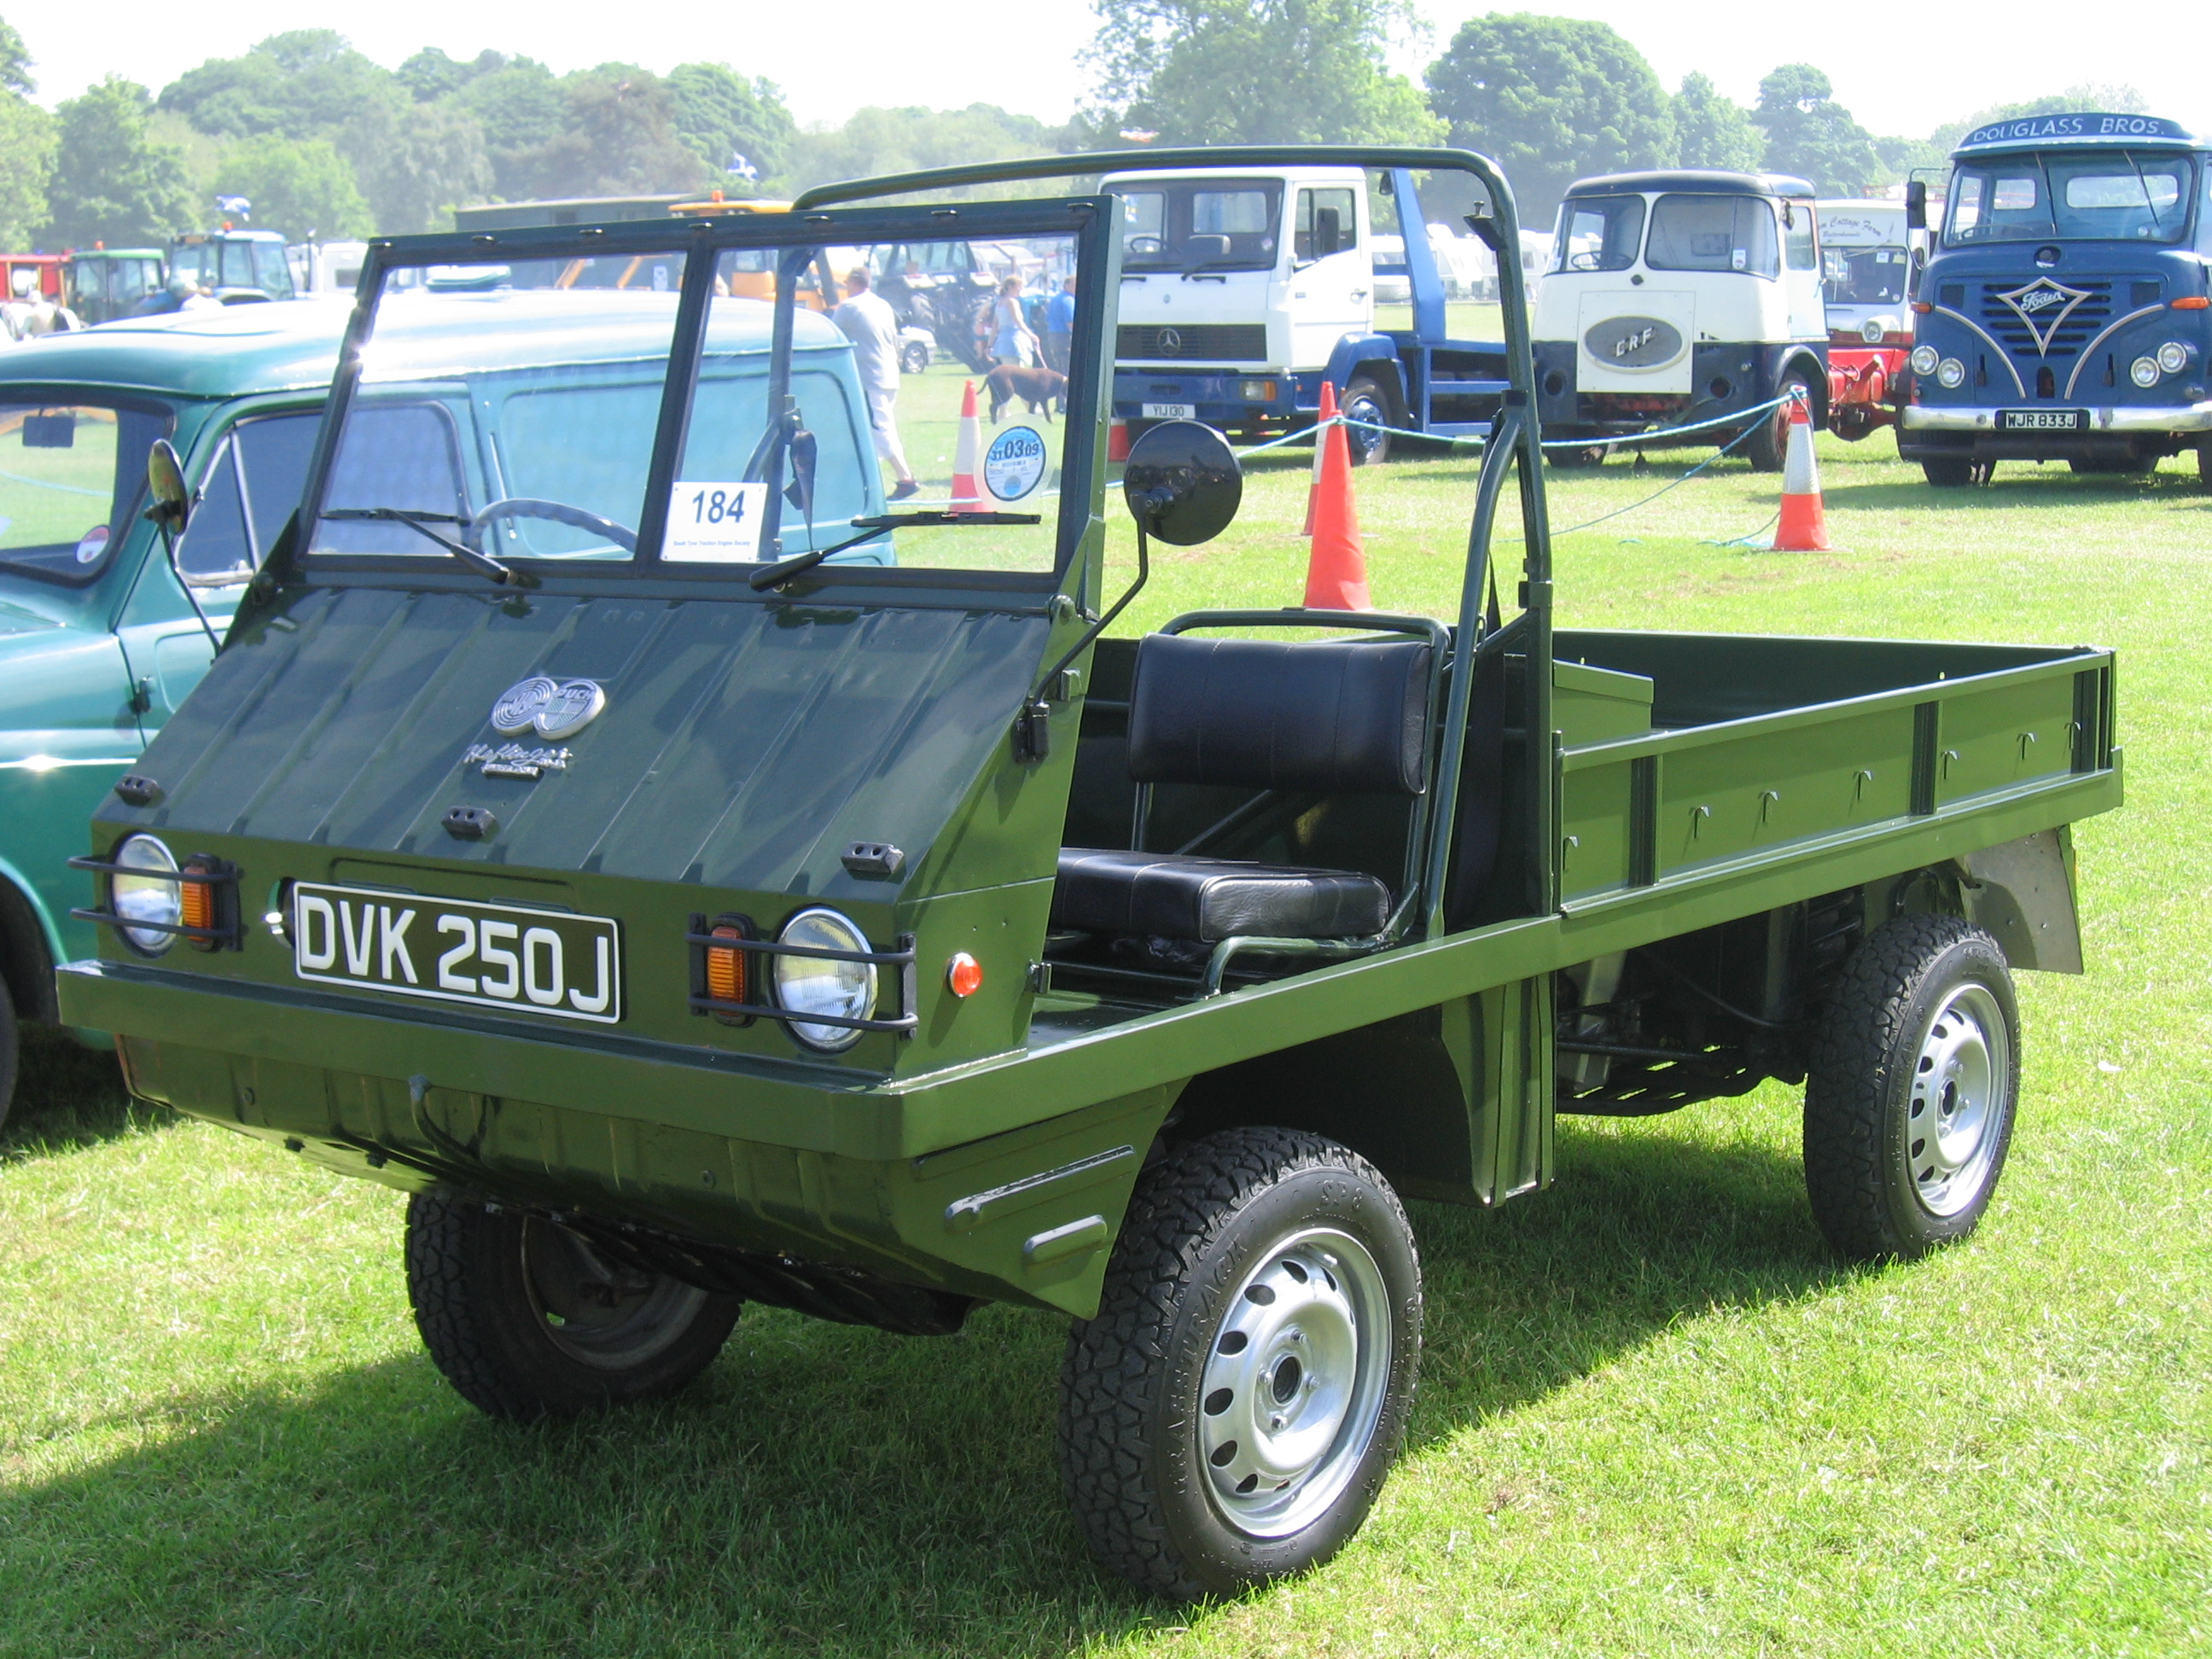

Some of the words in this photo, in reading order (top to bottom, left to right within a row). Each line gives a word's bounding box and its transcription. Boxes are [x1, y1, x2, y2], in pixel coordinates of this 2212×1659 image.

[1973, 118, 2083, 141] DOUGLASS
[2021, 291, 2065, 312] Foden
[2008, 414, 2034, 427] WJR
[2038, 414, 2075, 427] 833J
[1004, 439, 1024, 458] 03
[1025, 443, 1039, 457] 09
[692, 490, 745, 523] 184
[299, 894, 418, 985] DVK
[437, 913, 608, 1013] 250J
